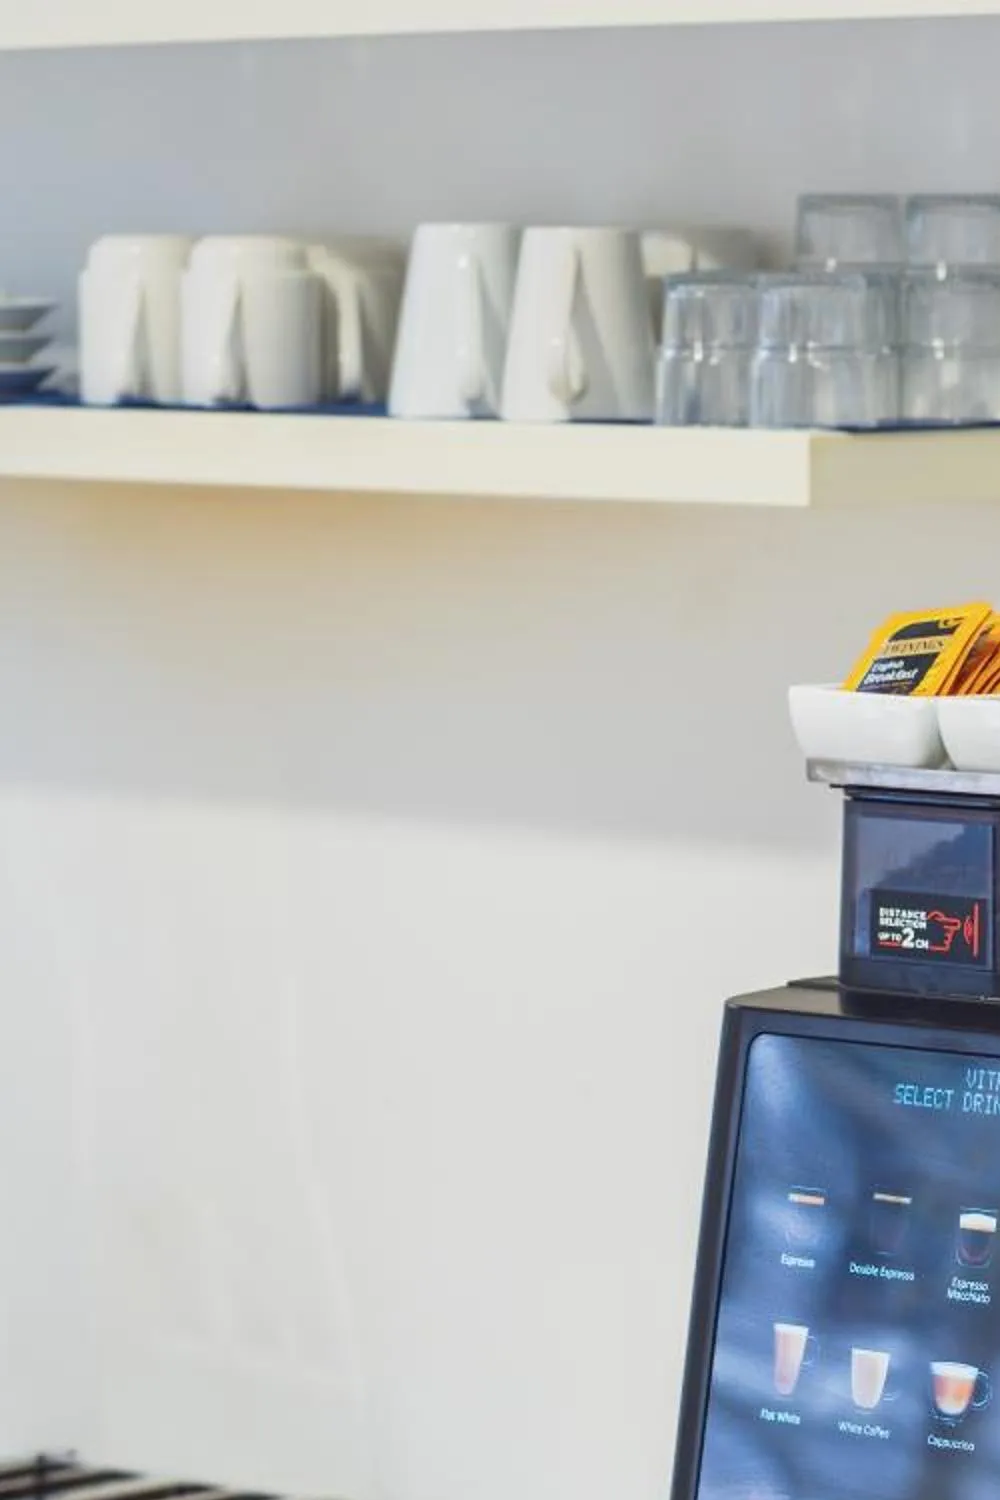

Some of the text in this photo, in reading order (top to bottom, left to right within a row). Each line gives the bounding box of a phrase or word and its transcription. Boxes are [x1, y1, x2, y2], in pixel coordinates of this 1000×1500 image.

[884, 639, 944, 655] TWININGS
[879, 907, 928, 921] DISTANCE
[879, 916, 927, 930] SELECTION
[877, 931, 890, 941] UP
[891, 932, 902, 944] TO
[901, 927, 915, 949] 2
[893, 1082, 955, 1110] SELECT
[849, 1261, 915, 1281] Double Espresso
[951, 1275, 989, 1292] Espresso
[776, 1410, 801, 1425] White
[837, 1420, 890, 1440] White Coffee
